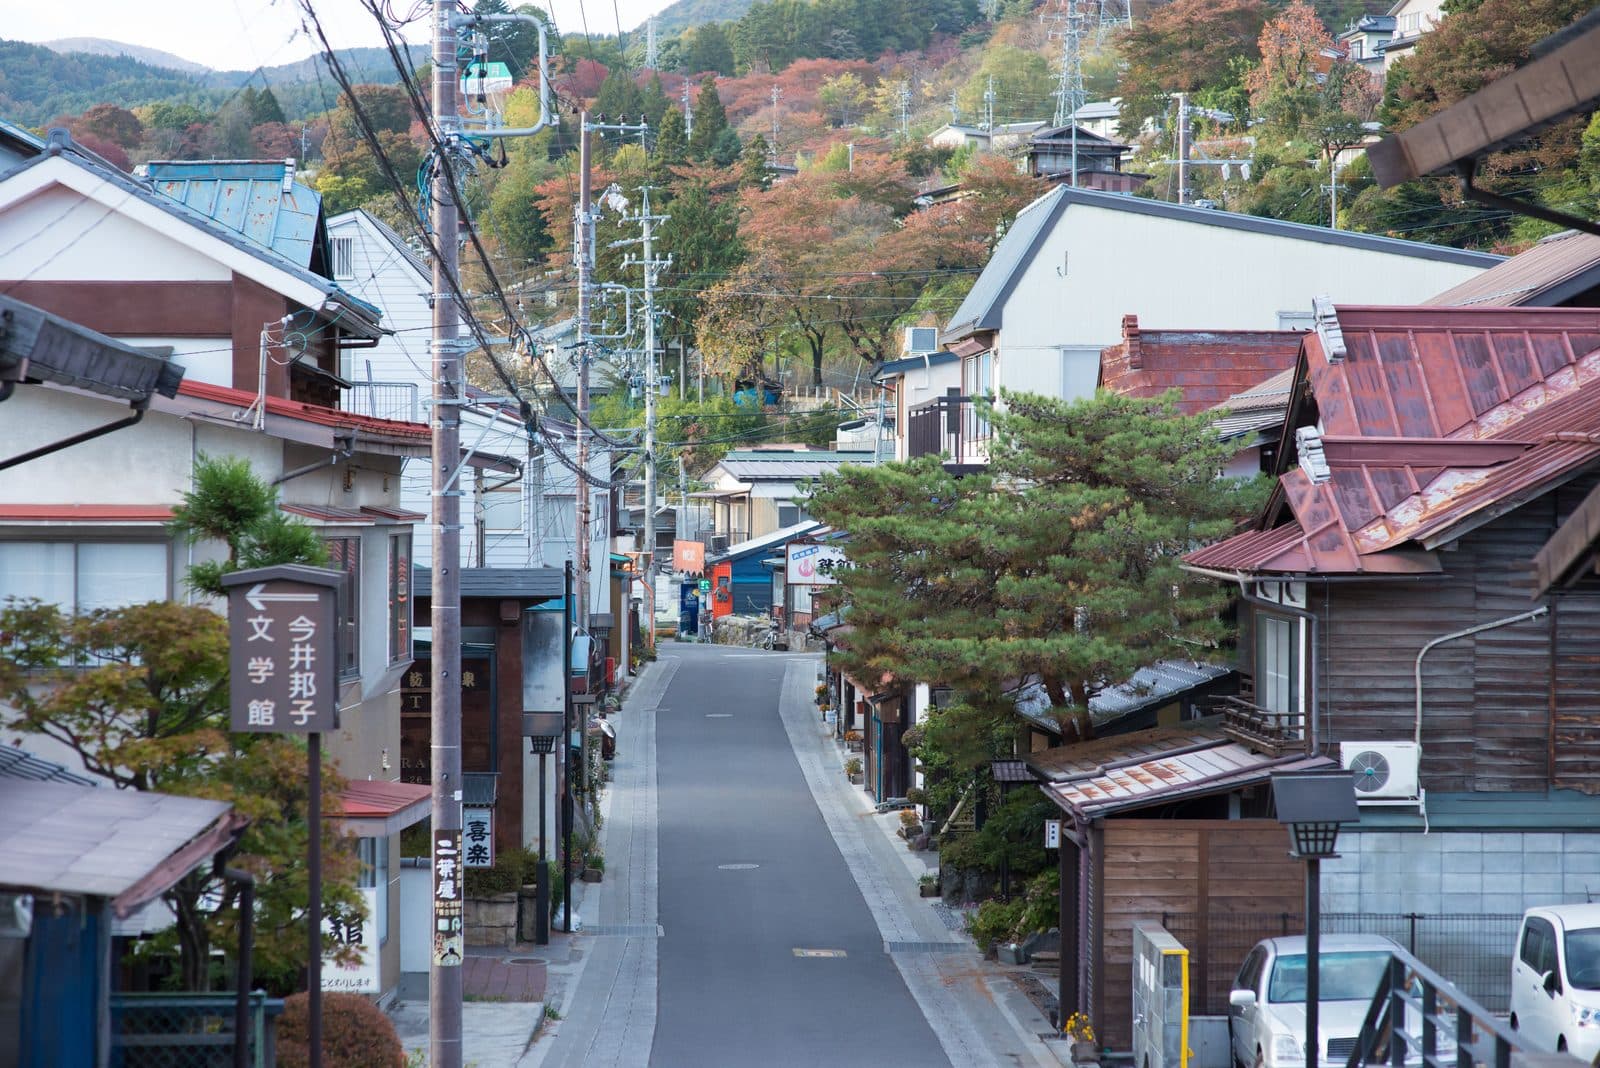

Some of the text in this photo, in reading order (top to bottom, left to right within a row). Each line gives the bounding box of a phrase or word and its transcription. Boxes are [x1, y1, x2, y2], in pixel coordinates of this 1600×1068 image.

[247, 615, 276, 726] 文学館
[288, 616, 317, 726] 今井邦子
[436, 839, 457, 899] 二葉屋
[466, 820, 491, 865] 喜楽
